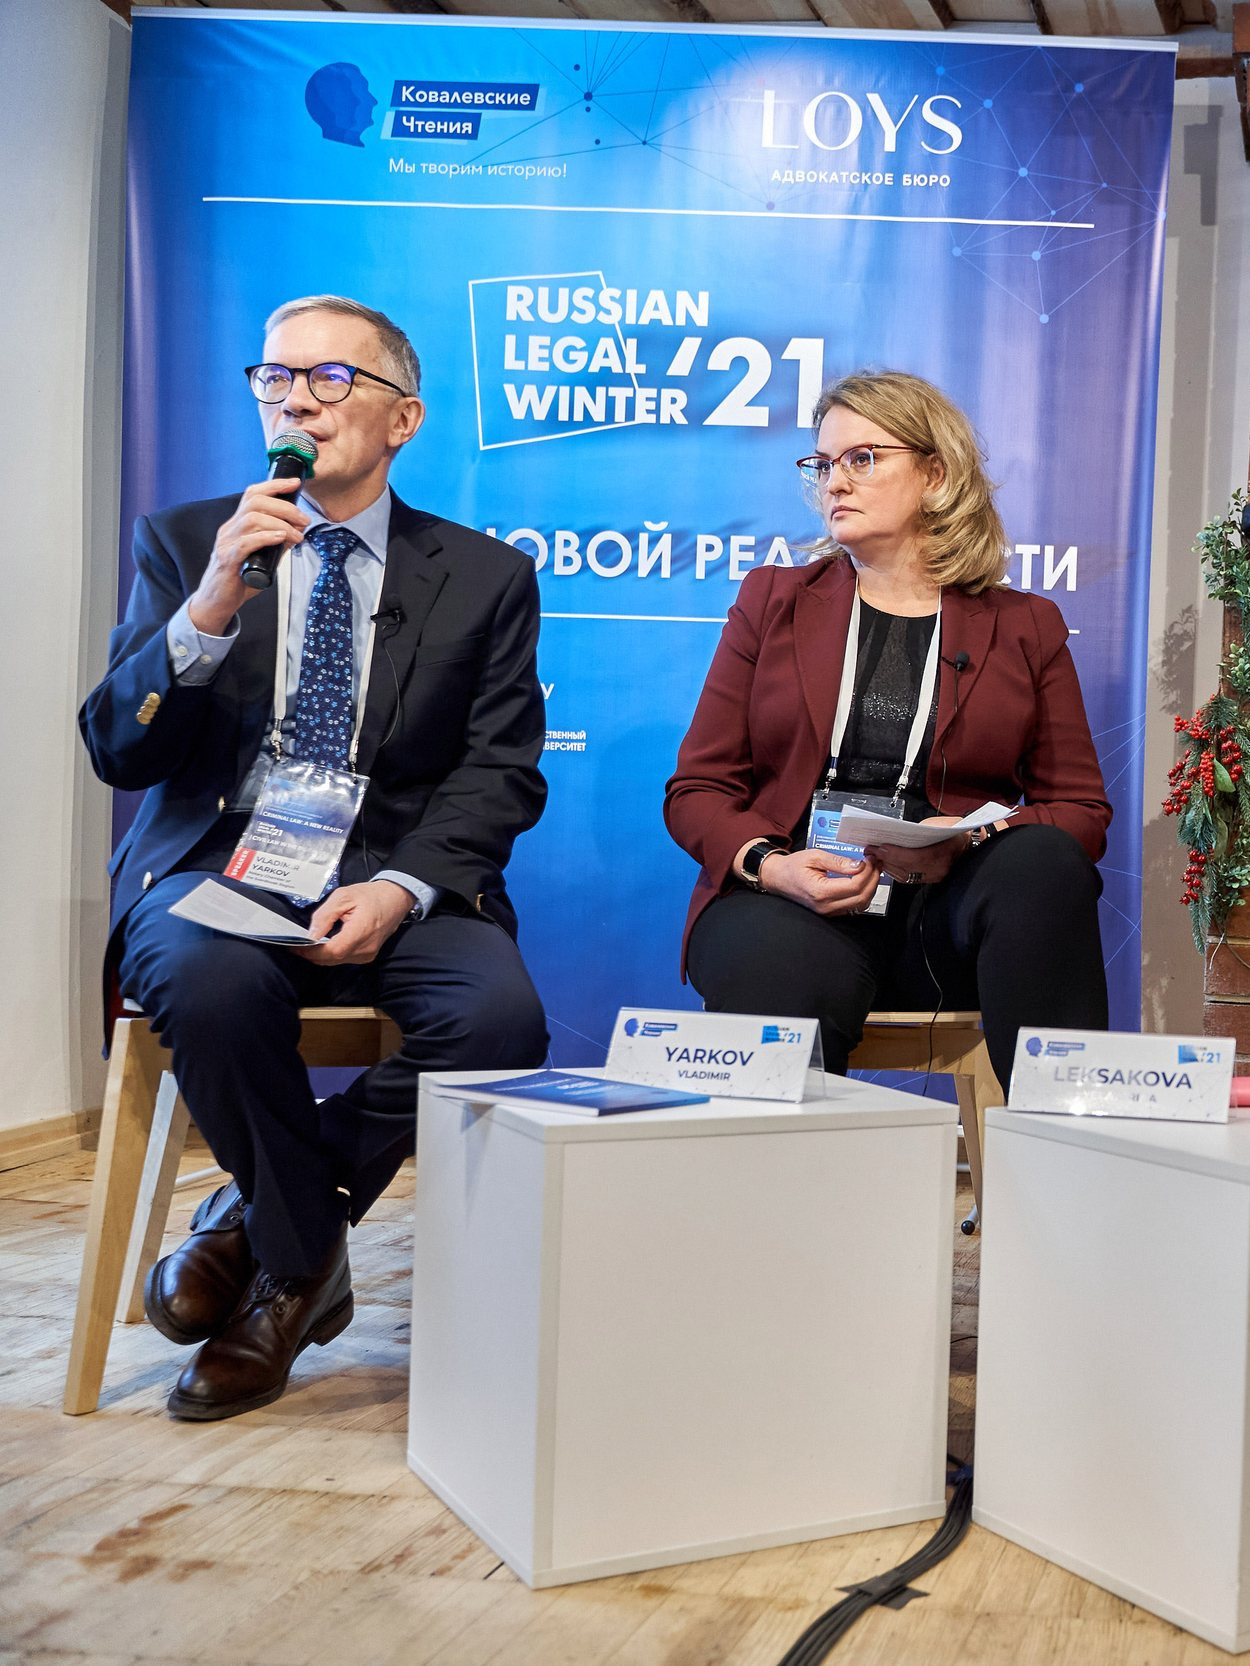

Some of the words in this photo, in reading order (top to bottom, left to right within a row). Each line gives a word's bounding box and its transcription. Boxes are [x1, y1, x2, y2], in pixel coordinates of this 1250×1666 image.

[401, 85, 532, 106] Ковалевские
[401, 116, 473, 135] Чтения
[761, 89, 963, 155] LOYS
[388, 158, 414, 175] Мы
[420, 163, 483, 179] творим
[487, 163, 567, 179] историю!
[771, 169, 894, 186] АДВОКАТСКОЕ
[902, 173, 951, 187] БЮРО
[505, 284, 710, 328] RUSSIAN
[503, 334, 647, 375] LEGAL
[503, 383, 689, 425] WINTER
[486, 520, 672, 578] ОВОЙ
[543, 741, 587, 752] ВЕРСИТЕТ
[252, 864, 290, 877] YARKOV
[665, 1047, 754, 1066] YARKOV
[678, 1070, 731, 1081] VLADIMIR
[1054, 1066, 1192, 1089] LEKSAKOVA
